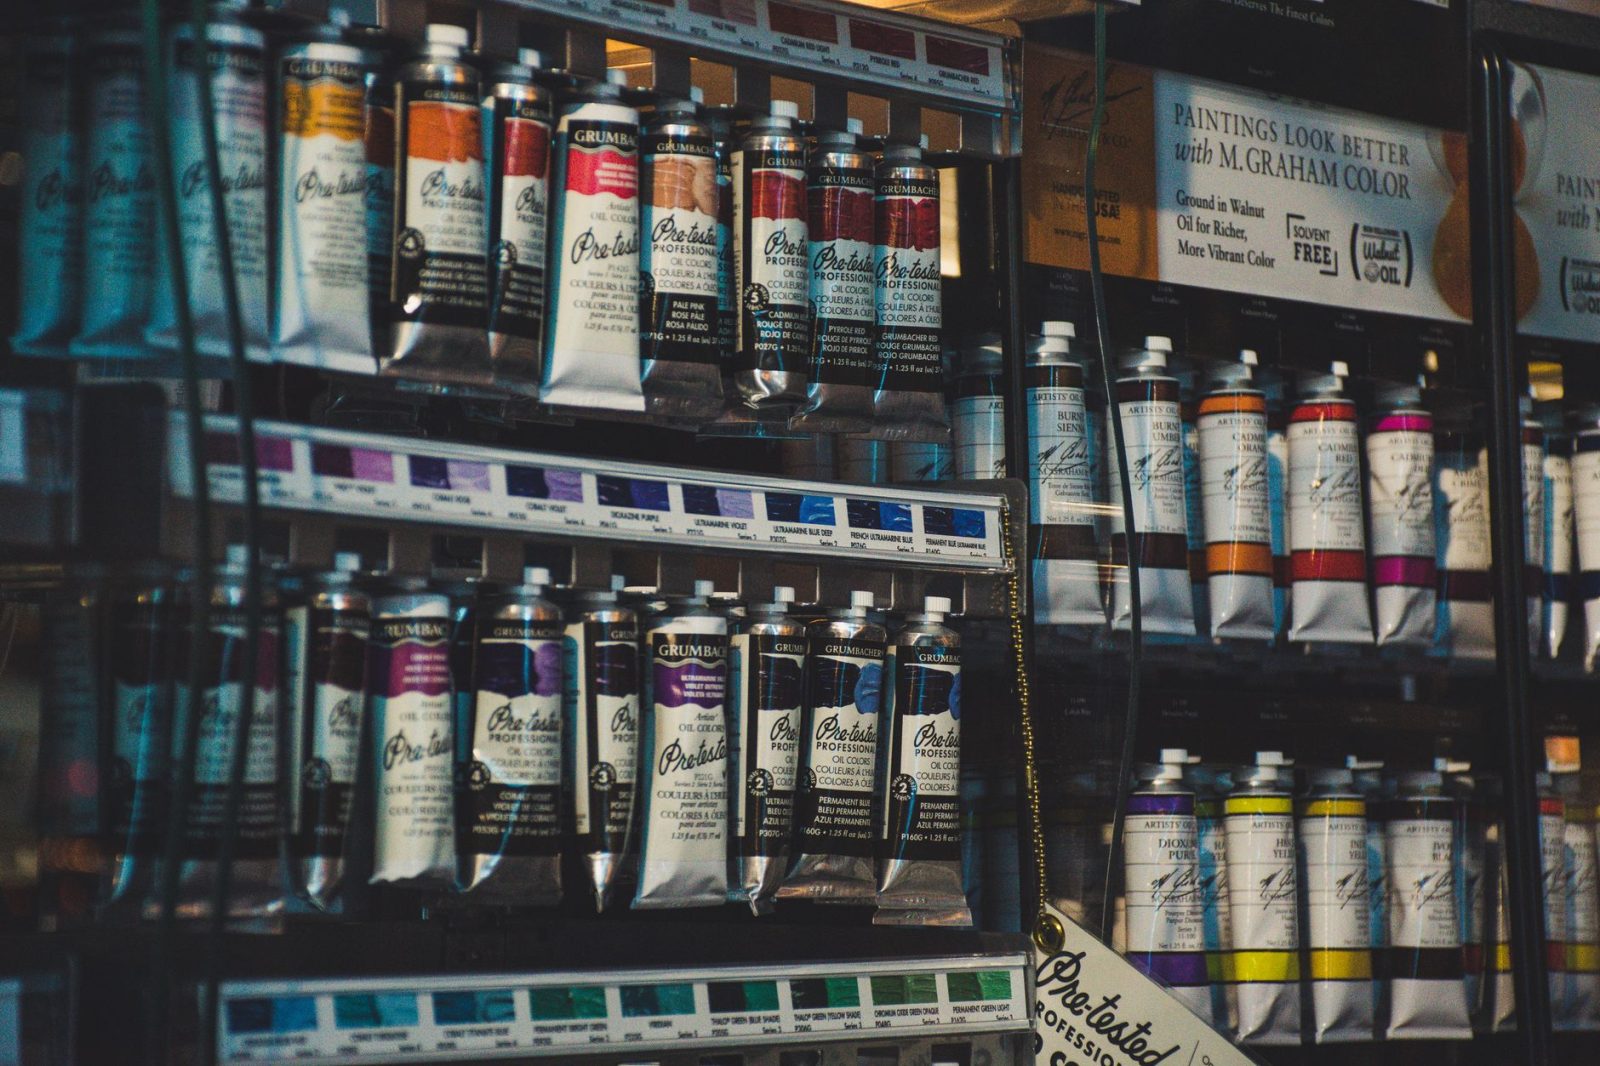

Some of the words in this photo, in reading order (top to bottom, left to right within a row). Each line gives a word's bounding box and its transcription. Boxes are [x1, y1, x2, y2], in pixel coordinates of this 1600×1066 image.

[1270, 2, 1283, 16] The
[1286, 6, 1308, 21] Finest
[1174, 103, 1279, 143] PAINTINGS
[1285, 124, 1336, 154] LOOK
[1343, 134, 1411, 167] BETTER
[1175, 138, 1213, 165] with
[1344, 165, 1412, 200] COLOR
[1176, 190, 1215, 210] Ground
[1218, 195, 1227, 212] in
[1230, 198, 1265, 218] Walnut
[1177, 215, 1193, 231] Oil
[1196, 217, 1211, 234] for
[1213, 220, 1248, 242] Richer,
[1294, 225, 1331, 242] SOLVENT
[1178, 239, 1205, 258] More
[1208, 243, 1245, 265] Vibrant
[1247, 251, 1276, 269] Color
[1294, 242, 1332, 266] FREE
[1363, 240, 1400, 262] Walnut
[1380, 265, 1401, 285] OIL
[751, 292, 759, 303] 5
[892, 292, 905, 301] OIL
[907, 293, 935, 302] COLORS
[673, 301, 688, 309] PALE
[690, 302, 705, 310] PINK
[877, 303, 917, 313] COULEURS
[672, 311, 689, 319] ROSE
[819, 306, 853, 316] COLORES
[880, 313, 917, 323] COLORES
[666, 320, 685, 330] ROSA
[757, 320, 783, 329] ROUGE
[829, 325, 854, 334] PYRROLE
[855, 326, 866, 334] RED
[760, 330, 781, 339] ROJO
[882, 332, 928, 342] GRUMBACHER
[928, 334, 939, 342] RED
[823, 344, 841, 353] ROJO
[876, 342, 901, 351] ROUGE
[878, 351, 897, 359] ROJO
[895, 363, 909, 372] 1.25
[773, 526, 808, 535] ULTRAMARINE
[809, 528, 820, 536] BLUE
[821, 529, 833, 537] DEEP
[850, 531, 869, 540] FRENCH
[870, 533, 901, 543] ULTRAMARINE
[902, 536, 913, 544] BLUE
[832, 755, 845, 764] OIL
[846, 756, 871, 766] COLORS
[930, 761, 941, 769] OIL
[815, 765, 855, 776] COULEURS
[916, 771, 951, 780] COULEURS
[599, 772, 608, 783] 3
[818, 776, 854, 787] COLORES
[755, 778, 764, 789] 2
[899, 782, 908, 793] 2
[919, 783, 951, 792] COLORES
[819, 796, 858, 805] PERMANENT
[859, 798, 871, 807] BLUE
[920, 802, 955, 811] PERMANENT
[660, 810, 703, 820] COLORES
[818, 806, 835, 814] BLEU
[835, 807, 870, 816] PERMANENT
[920, 811, 934, 819] BLEU
[814, 816, 832, 824] AZUL
[916, 821, 932, 829] AZUL
[828, 828, 842, 837] 1.25
[953, 1006, 980, 1014] PERMANENT
[981, 1005, 996, 1013] GREEN
[997, 1004, 1010, 1012] LIGHT
[1036, 950, 1181, 1066] Pre-tested
[1036, 1000, 1122, 1066] ROFESSIO
